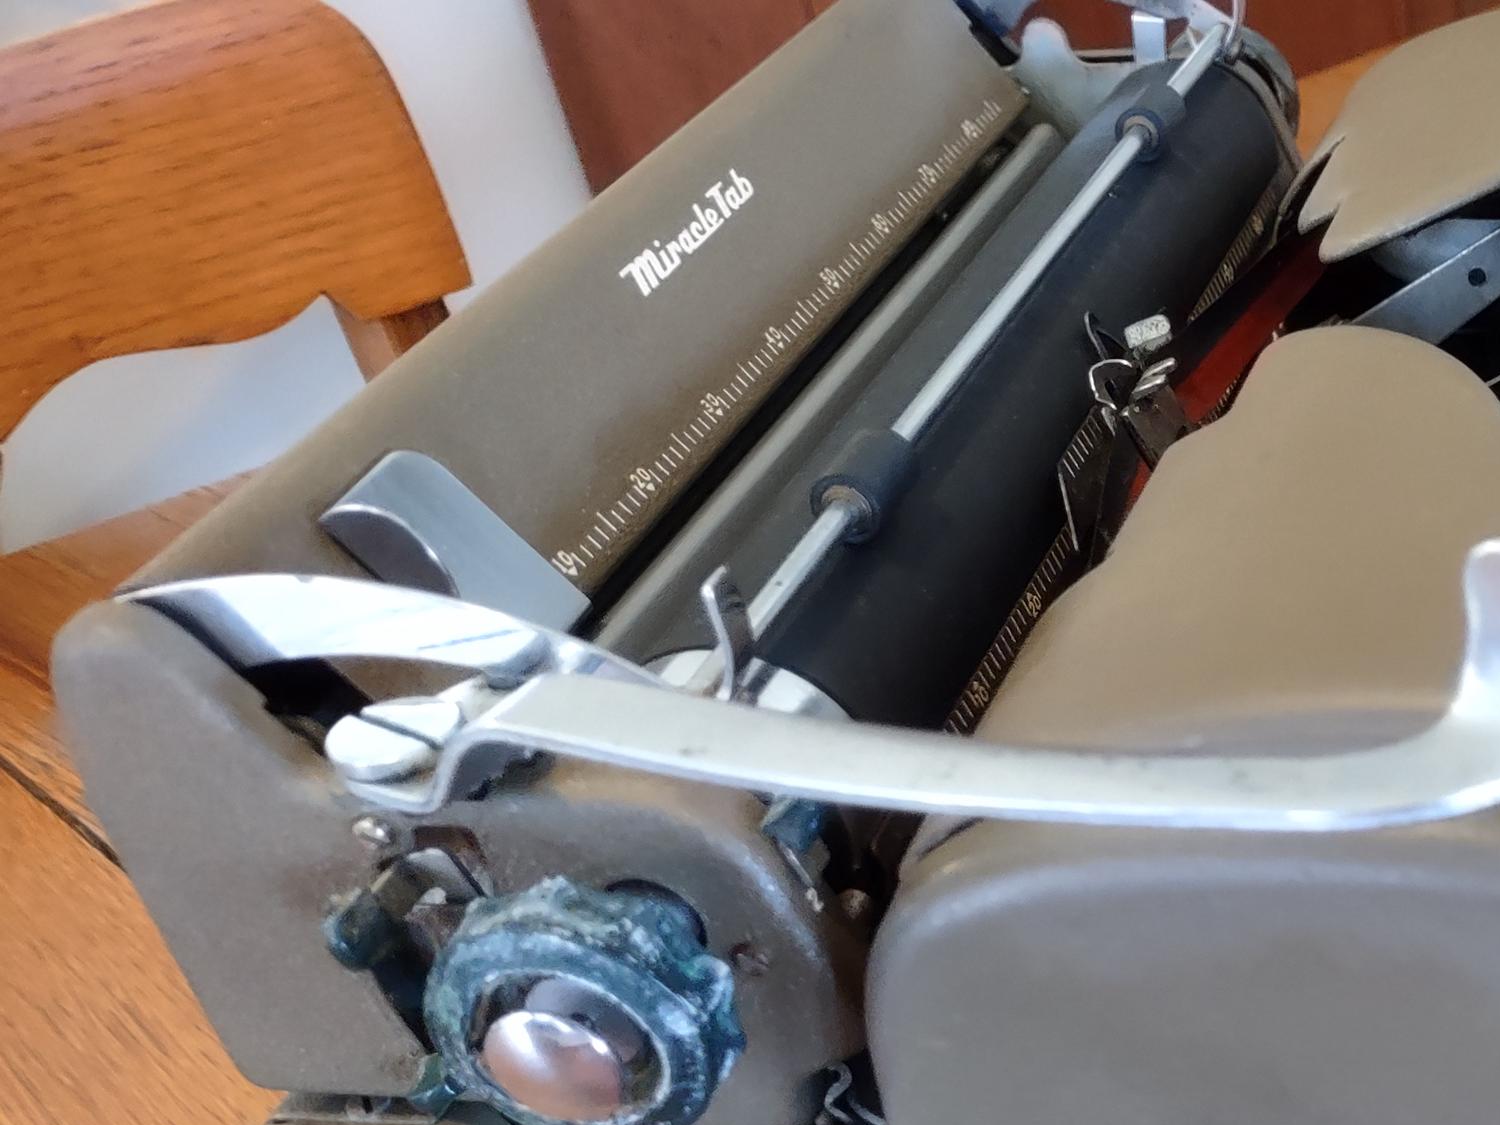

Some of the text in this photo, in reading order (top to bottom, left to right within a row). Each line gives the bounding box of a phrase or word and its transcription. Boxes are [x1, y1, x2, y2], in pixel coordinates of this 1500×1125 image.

[819, 267, 836, 285] 50
[764, 326, 782, 346] 40
[700, 393, 720, 413] 30
[630, 468, 650, 489] 20
[553, 550, 576, 573] 10
[1028, 595, 1042, 618] 20
